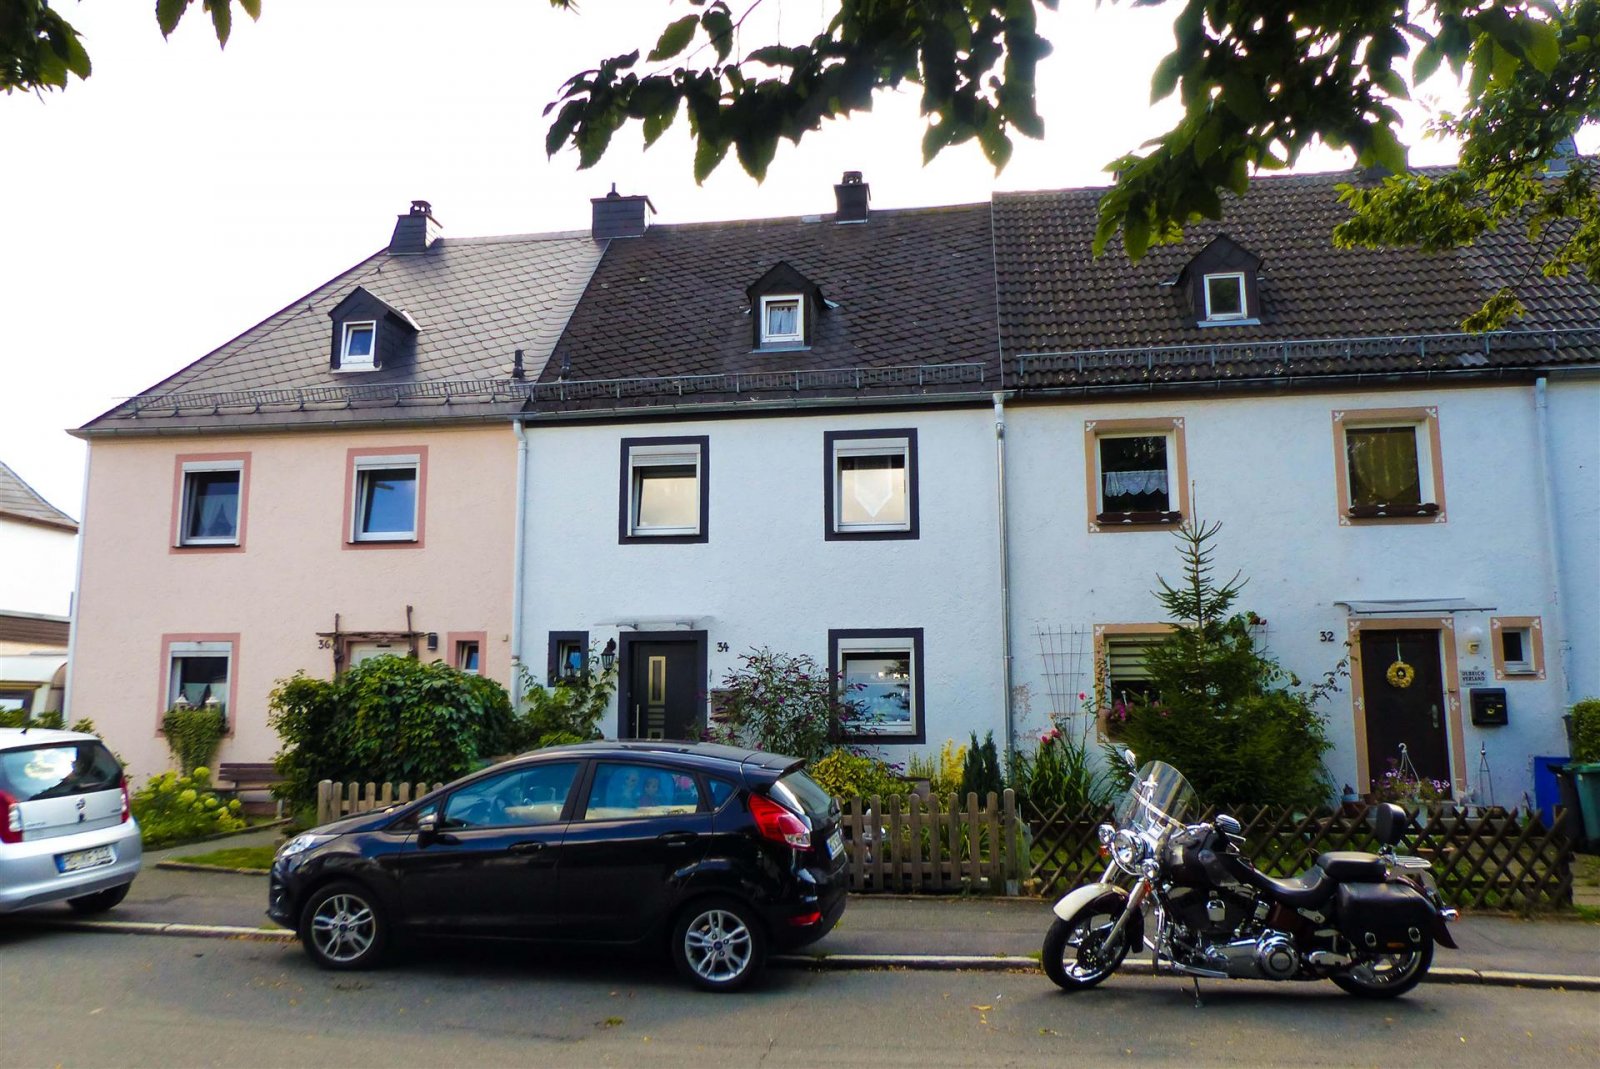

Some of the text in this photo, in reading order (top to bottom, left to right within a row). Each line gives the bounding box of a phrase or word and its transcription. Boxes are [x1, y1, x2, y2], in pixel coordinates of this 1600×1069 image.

[1320, 631, 1335, 642] 32
[318, 639, 331, 649] 36
[717, 641, 729, 653] 34
